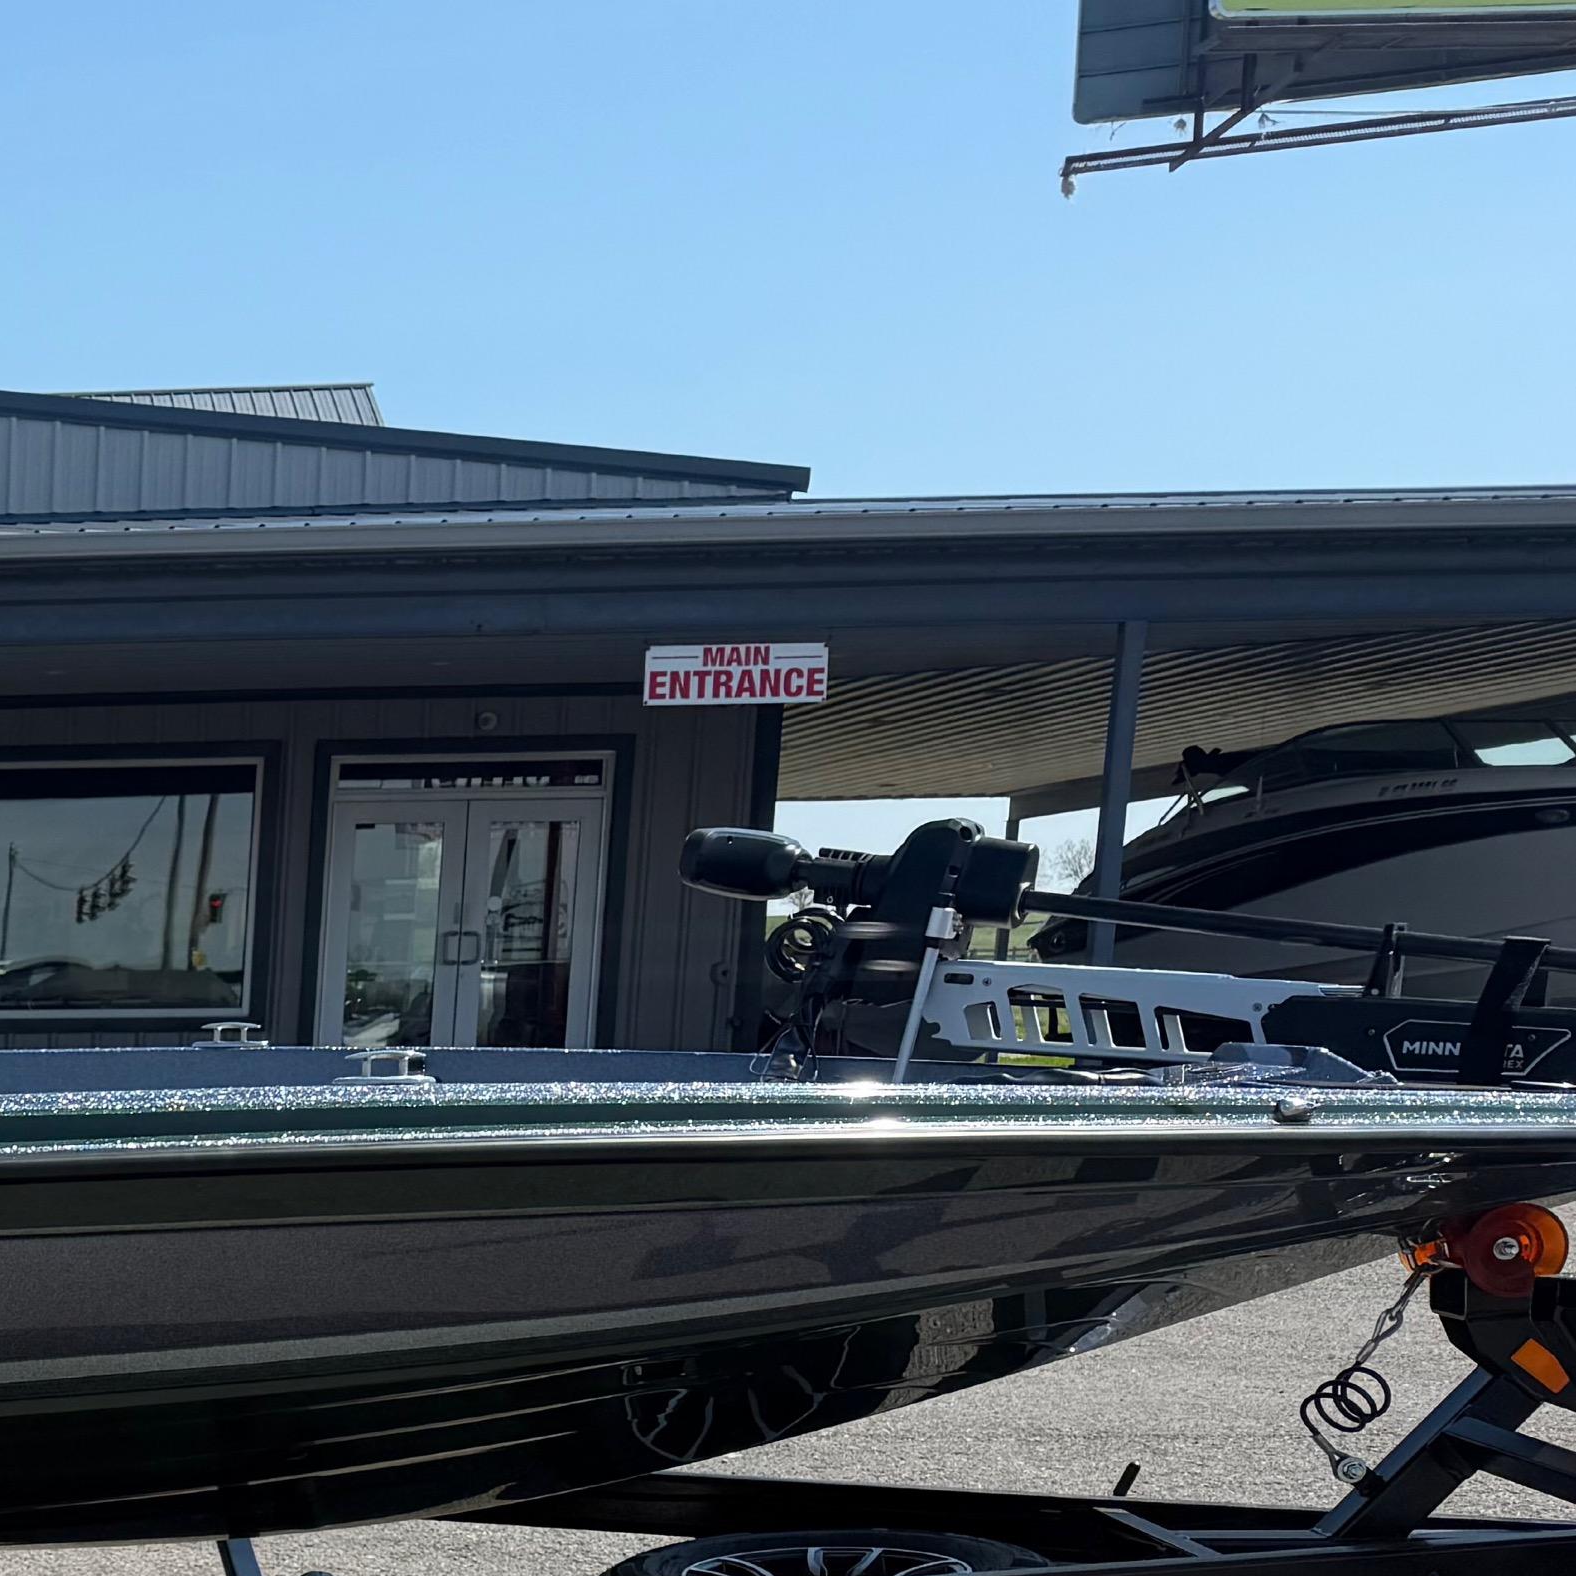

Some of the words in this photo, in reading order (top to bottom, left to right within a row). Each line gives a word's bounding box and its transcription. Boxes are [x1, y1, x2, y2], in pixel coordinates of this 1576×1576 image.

[702, 645, 771, 667] MAIN
[648, 667, 826, 700] ENTRANCE
[1402, 1040, 1462, 1056] MINN
